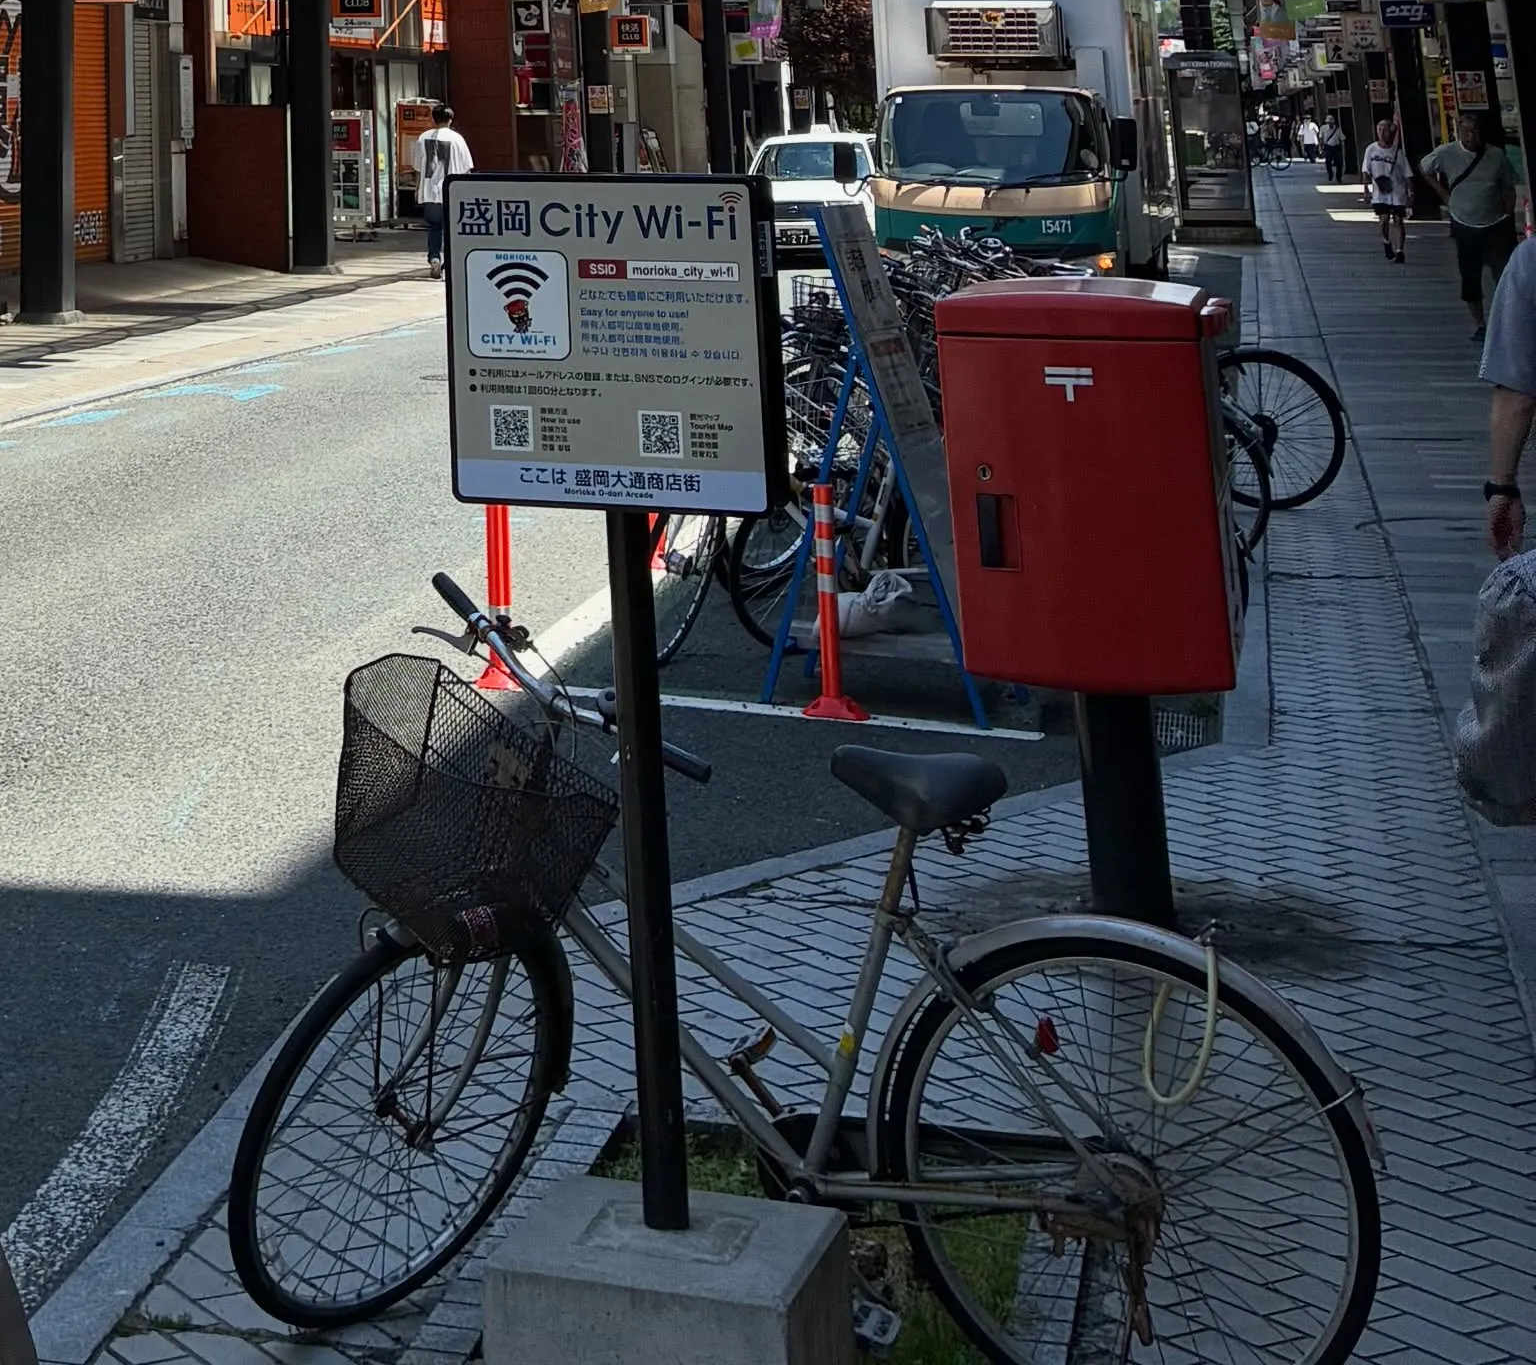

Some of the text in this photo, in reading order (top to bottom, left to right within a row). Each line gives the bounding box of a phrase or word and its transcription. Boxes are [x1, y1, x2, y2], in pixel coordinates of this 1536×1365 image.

[457, 198, 738, 244] 盛岡 City Wi-Fi
[1041, 220, 1072, 234] 15471
[496, 254, 538, 262] MORIOKA
[589, 263, 735, 280] SSID morioka_city_wi-fi
[579, 291, 750, 304] どなたでも簡単にご利用いただけます。
[580, 308, 689, 319] Easy for anyone to use!
[481, 334, 557, 347] CITY Wi-Fi
[690, 422, 734, 432] Tourist Map
[519, 466, 701, 493] ここは 盛岡大通商店街
[564, 488, 596, 496] Morioka
[625, 490, 654, 499] Arcade
